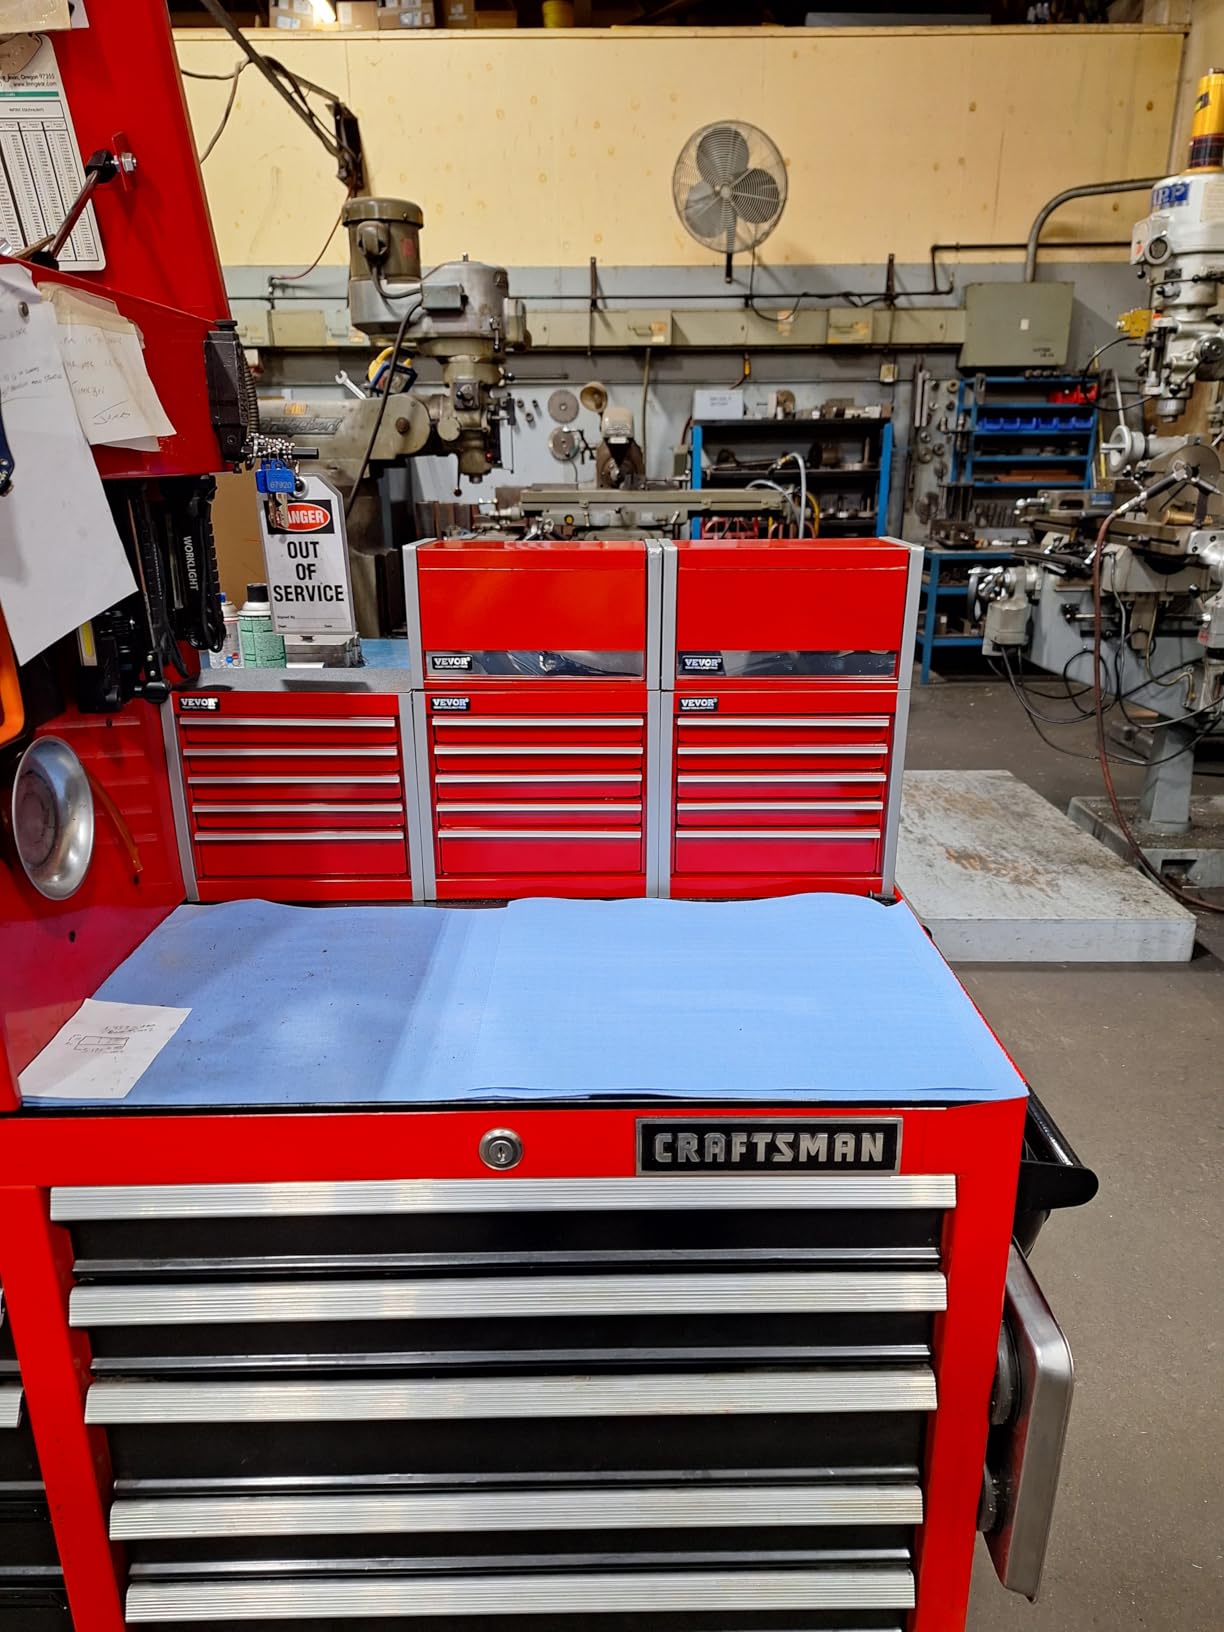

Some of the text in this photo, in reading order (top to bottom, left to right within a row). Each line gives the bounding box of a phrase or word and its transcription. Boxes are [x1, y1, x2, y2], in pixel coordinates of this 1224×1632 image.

[287, 541, 319, 559] OUT
[183, 536, 199, 591] WORKLIGHT
[295, 563, 316, 580] OF
[273, 585, 344, 602] SERVICE
[433, 657, 468, 666] VEVOR
[684, 658, 718, 667] VEVOR
[432, 698, 467, 706] VEVOR
[681, 699, 714, 707] VEVOR
[654, 1132, 884, 1163] CRAFTSMAN
